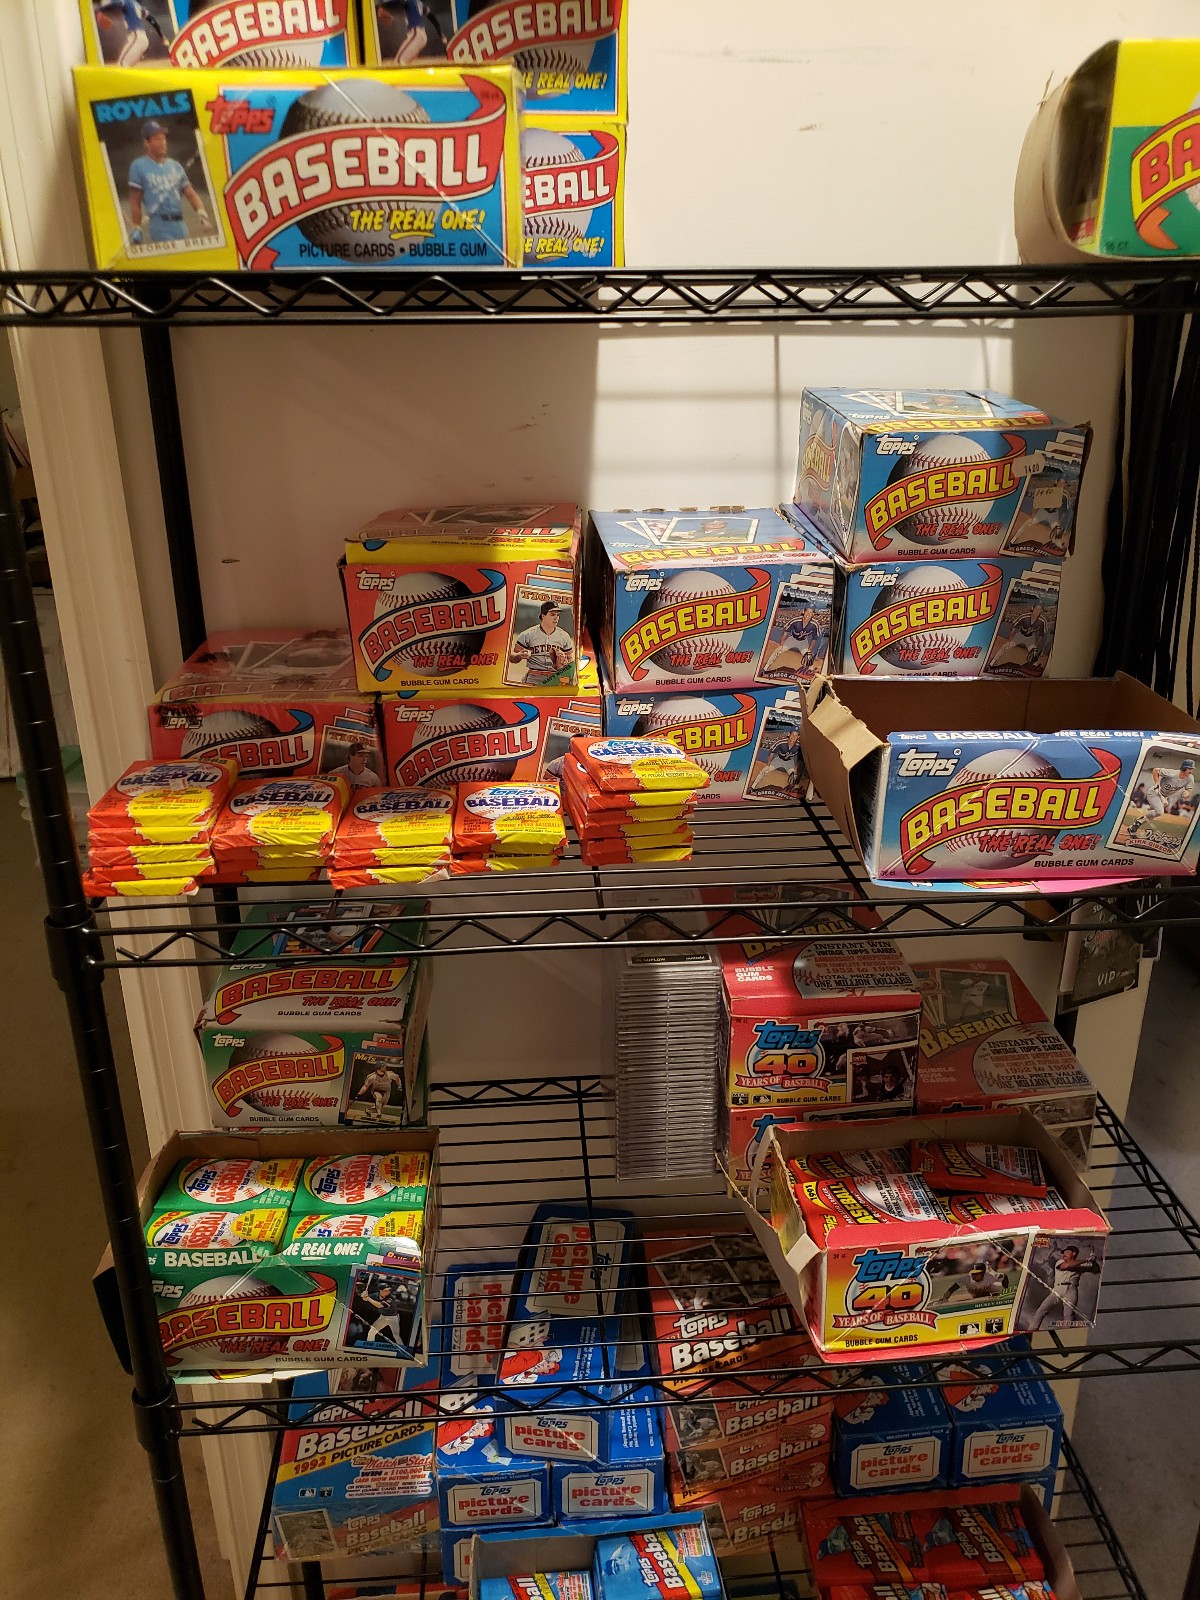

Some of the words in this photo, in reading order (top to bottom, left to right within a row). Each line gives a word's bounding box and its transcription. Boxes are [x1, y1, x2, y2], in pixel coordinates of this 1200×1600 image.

[175, 0, 341, 67] BASEBALL
[452, 0, 614, 63] BASEBALL
[537, 73, 570, 90] REAL
[574, 73, 607, 89] ONE!
[94, 92, 191, 123] ROYALS
[234, 134, 488, 241] BASEBALL
[350, 210, 384, 231] THE
[390, 209, 435, 232] REAL
[441, 209, 486, 231] ONE!
[131, 241, 177, 254] GEORGE
[185, 236, 221, 249] BRETT
[300, 242, 349, 258] PICTURE
[354, 242, 396, 258] CARDS
[410, 242, 455, 258] BUBBLE
[459, 242, 488, 258] GUM
[536, 237, 568, 254] REAL
[574, 237, 605, 253] ONE!
[867, 415, 1046, 432] BASEBALL
[876, 435, 917, 455] Topps
[870, 463, 1015, 531] BASEBALL
[915, 523, 936, 537] THE
[939, 523, 969, 537] REAL
[972, 522, 1002, 536] ONE!
[620, 541, 798, 562] BASEBALL
[897, 549, 928, 557] BUBBLE
[931, 548, 949, 556] GUM
[950, 547, 975, 556] CARDS
[356, 571, 396, 591] Topps
[624, 573, 664, 591] Topps
[860, 567, 899, 587] Topps
[364, 596, 500, 664] BASEBALL
[625, 596, 762, 664] BASEBALL
[855, 590, 992, 661] BASEBALL
[413, 655, 435, 667] THE
[437, 654, 467, 668] REAL
[471, 652, 499, 666] ONE!
[669, 654, 692, 667] THE
[693, 653, 723, 667] REAL
[725, 651, 753, 665] ONE!
[898, 648, 919, 661] THE
[921, 648, 951, 662] REAL
[953, 646, 981, 660] ONE!
[400, 679, 432, 687] BUBBLE
[452, 677, 479, 685] CARDS
[655, 678, 685, 686] BUBBLE
[687, 677, 703, 685] GUM
[705, 675, 731, 684] CARDS
[394, 704, 434, 722] Topps
[615, 699, 653, 716] Topps
[400, 727, 532, 786] BASEBALL
[898, 748, 957, 777] Topps
[715, 770, 741, 783] ONE!
[234, 791, 333, 807] BASEBALL
[357, 800, 451, 814] BASEBALL
[466, 797, 559, 808] BASEBALL
[907, 786, 1101, 845] BASEBALL
[979, 835, 1010, 853] THE
[1013, 834, 1055, 854] REAL
[1060, 833, 1102, 852] ONE!
[1148, 841, 1173, 854] GIBSON
[1034, 859, 1074, 868] BUBBLE
[1076, 858, 1099, 868] GUM
[1100, 858, 1134, 867] CARDS
[814, 942, 865, 950] INSTANT
[868, 941, 892, 949] WIN
[222, 970, 394, 1008] BASEBALL
[814, 980, 832, 988] ONE
[835, 979, 871, 987] MILLION
[874, 976, 912, 986] DOLLARS
[212, 1033, 246, 1047] Topps
[754, 1021, 823, 1049] Topps
[920, 1012, 1022, 1059] BASEBALL
[986, 1038, 1035, 1048] INSTANT
[1037, 1036, 1061, 1044] WIN
[355, 1053, 377, 1063] Mets
[754, 1053, 817, 1074] 40
[217, 1054, 340, 1104] BASEBALL
[742, 1077, 768, 1087] YEARS
[769, 1076, 782, 1086] OF
[784, 1078, 826, 1089] BASEBALL
[187, 1169, 217, 1193] Topps
[216, 1159, 255, 1203] BASEBALL
[314, 1168, 341, 1195] Topps
[345, 1155, 374, 1203] BASEBALL
[804, 1184, 818, 1201] 1991
[153, 1211, 181, 1234] 1990
[297, 1214, 320, 1234] 1990
[164, 1223, 189, 1245] Topps
[164, 1250, 266, 1267] BASEBALL
[544, 1233, 570, 1294] cards
[564, 1226, 590, 1305] picture
[855, 1250, 928, 1282] Topps
[853, 1283, 923, 1311] 40
[673, 1313, 727, 1338] Topps
[838, 1314, 866, 1327] YEARS
[867, 1312, 883, 1323] OF
[886, 1312, 932, 1326] BASEBALL
[219, 1340, 254, 1353] THE
[255, 1340, 290, 1354] REAL
[294, 1339, 330, 1352] ONE!
[671, 1308, 792, 1371] Baseball
[846, 1338, 873, 1348] BUBBLE
[876, 1337, 892, 1347] GUM
[894, 1334, 918, 1344] CARDS
[536, 1416, 569, 1429] Topps
[725, 1396, 819, 1435] Baseball
[296, 1401, 422, 1461] Baseball
[515, 1425, 586, 1441] picture
[995, 1432, 1026, 1443] Topps
[293, 1457, 328, 1475] 1992
[331, 1437, 383, 1463] PICTURE
[384, 1422, 425, 1445] CARDS
[523, 1437, 580, 1451] cards
[883, 1444, 913, 1455] Topps
[973, 1441, 1040, 1458] picture
[730, 1439, 820, 1476] Baseball
[861, 1453, 928, 1470] picture
[980, 1453, 1033, 1466] cards
[868, 1464, 922, 1478] cards
[594, 1475, 626, 1486] Topps
[480, 1485, 512, 1496] Topps
[571, 1485, 642, 1499] picture
[459, 1494, 529, 1509] picture
[580, 1496, 636, 1507] cards
[467, 1505, 524, 1518] cards
[739, 1503, 776, 1522] Topps
[346, 1509, 427, 1547] Baseball
[642, 1557, 661, 1587] Topps
